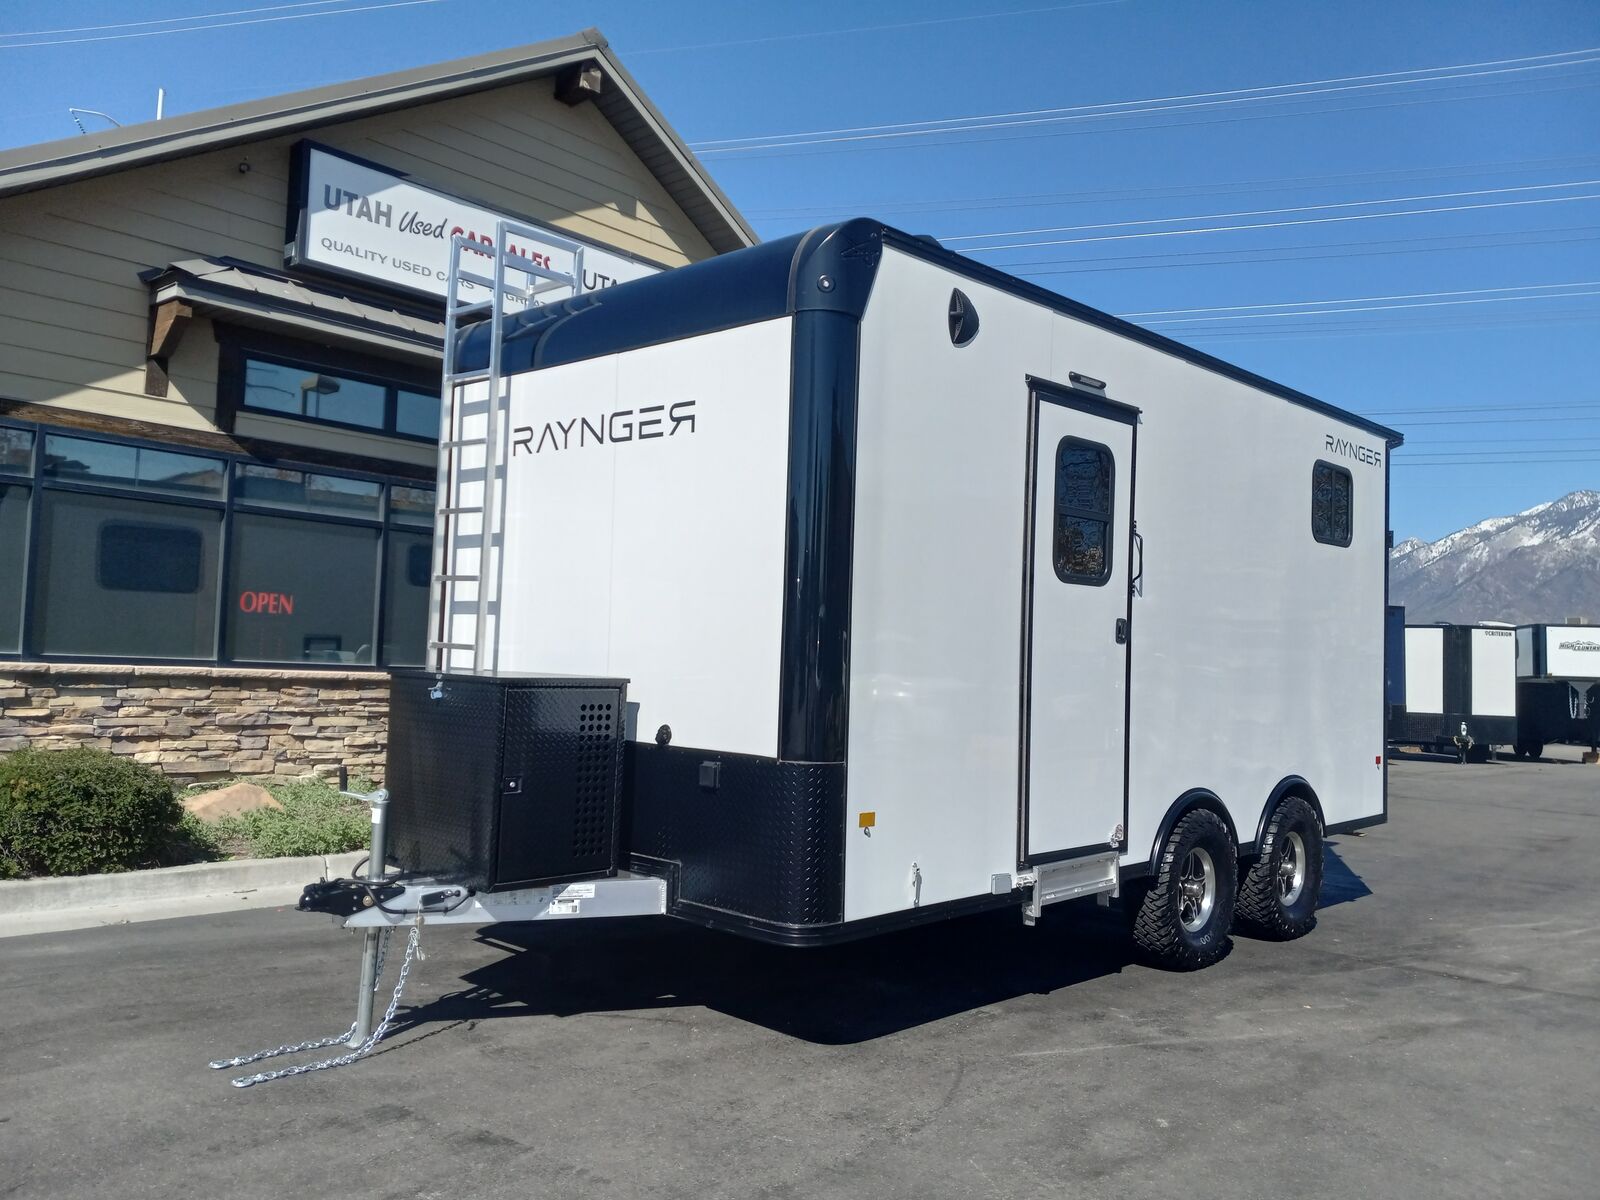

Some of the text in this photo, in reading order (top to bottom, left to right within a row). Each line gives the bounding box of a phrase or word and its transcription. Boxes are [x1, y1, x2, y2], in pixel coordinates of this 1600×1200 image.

[324, 183, 392, 228] UTAH
[398, 211, 448, 239] Used
[320, 237, 388, 265] QUALITY
[392, 257, 432, 277] USED
[436, 271, 475, 290] CRS
[513, 400, 696, 457] RAYNGER
[1325, 434, 1381, 468] RAYNGER
[239, 591, 295, 615] OPEN
